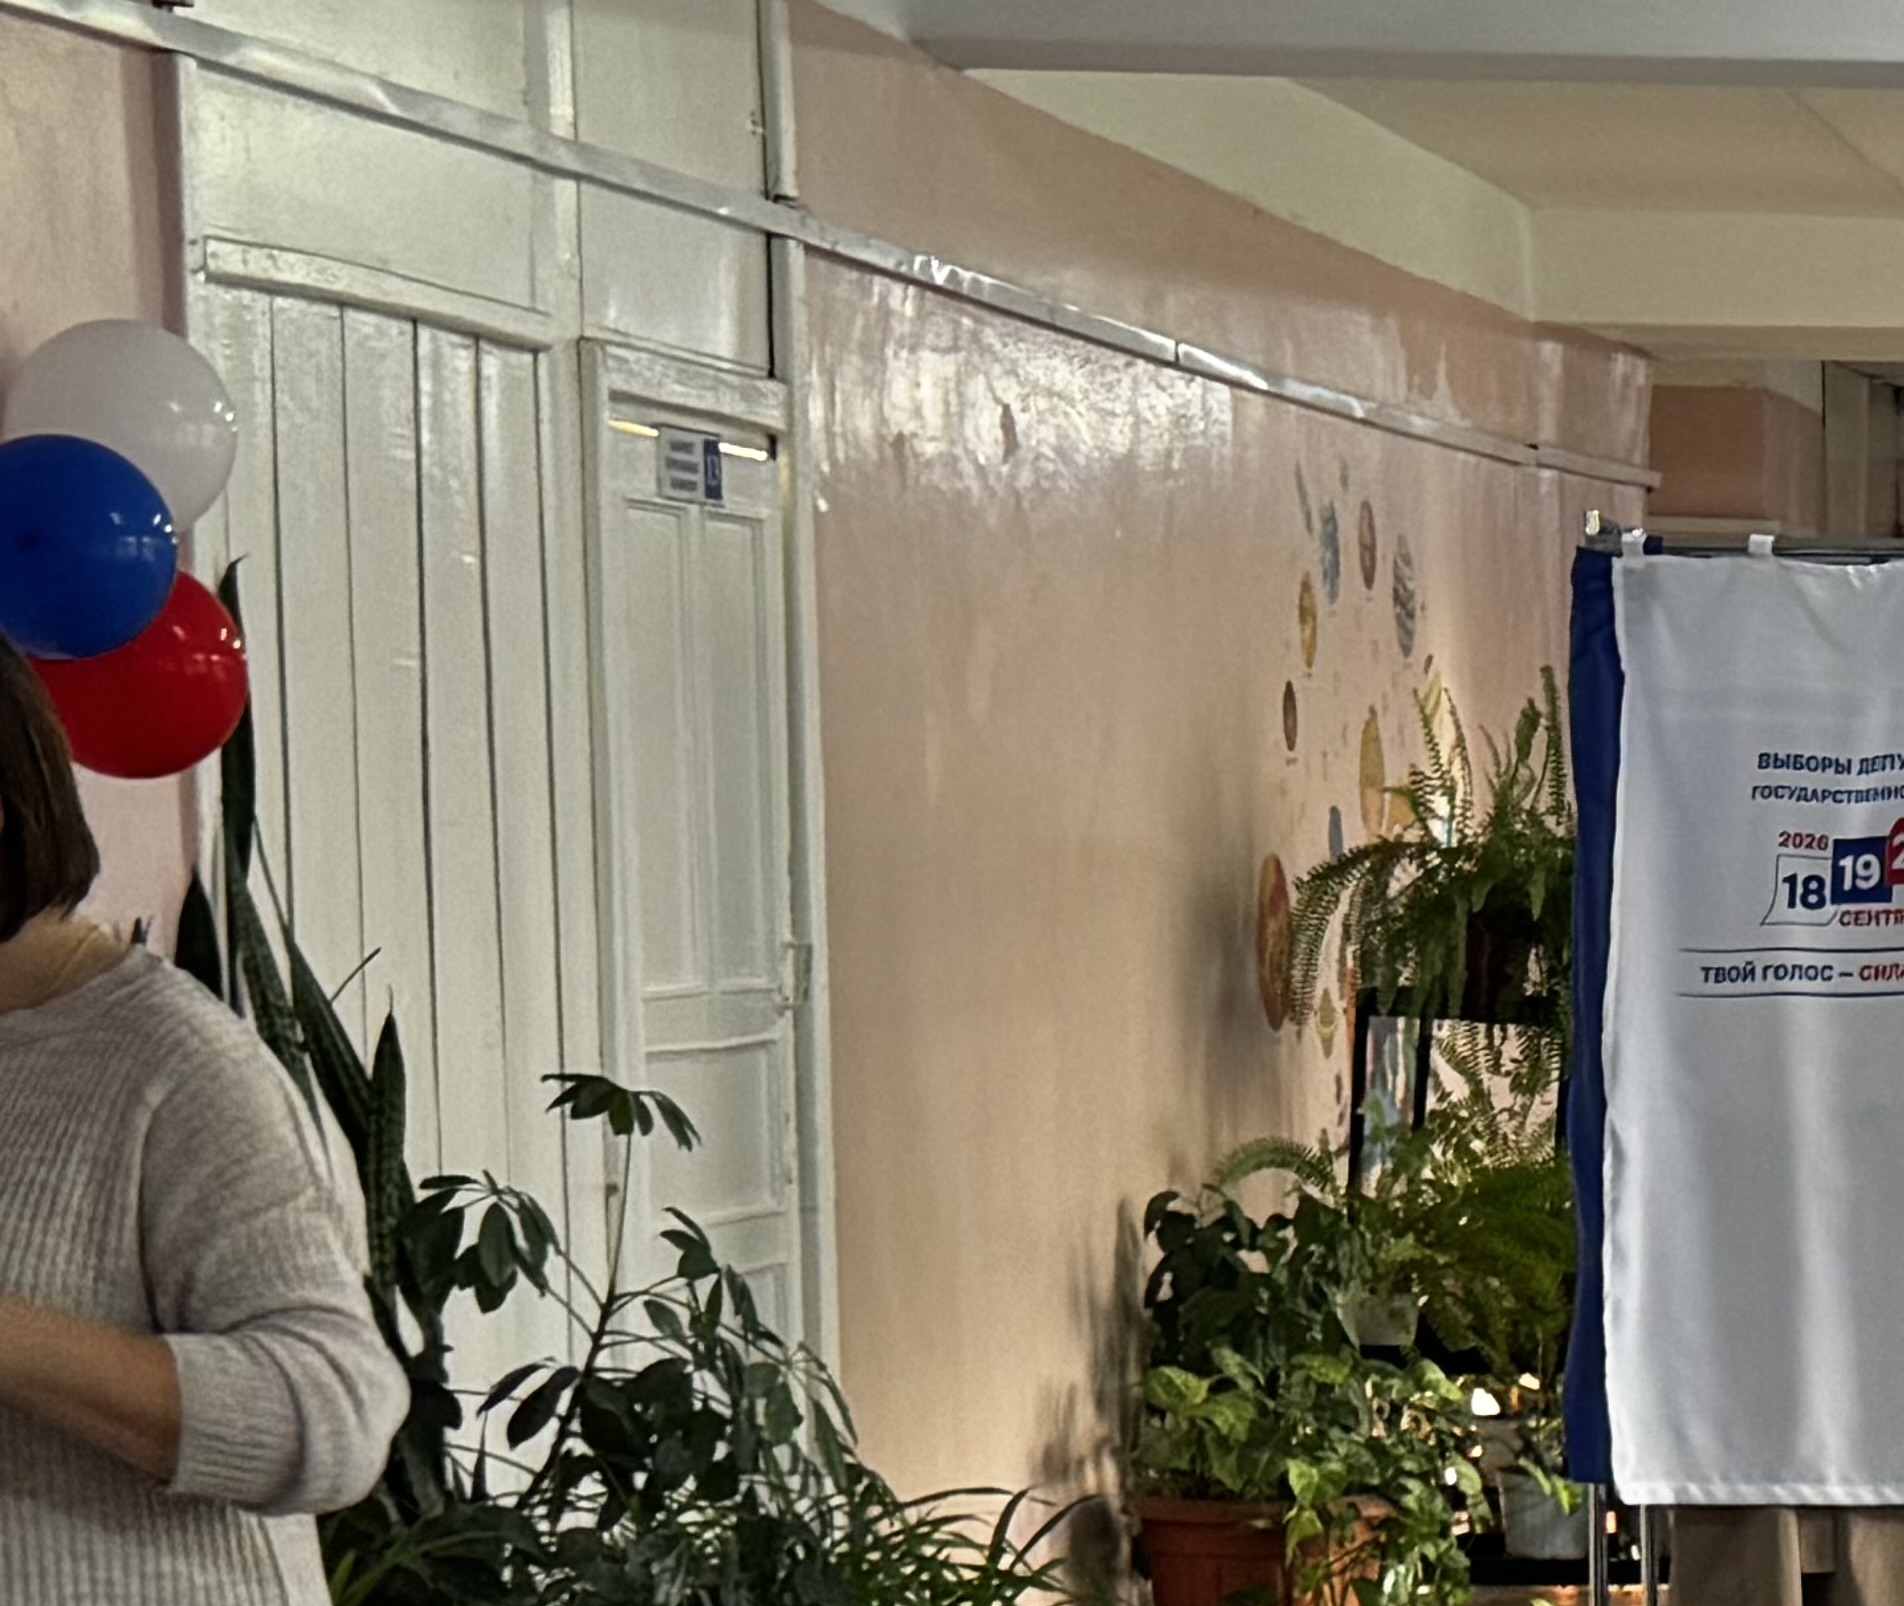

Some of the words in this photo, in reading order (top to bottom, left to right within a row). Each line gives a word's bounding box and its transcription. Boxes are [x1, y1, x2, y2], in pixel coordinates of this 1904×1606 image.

[1757, 752, 1852, 775] ВЫБОРЫ
[1778, 830, 1830, 851] 2026
[1782, 873, 1827, 910] 18
[1838, 853, 1881, 892] 19
[1701, 961, 1756, 984] ТВОЙ
[1761, 962, 1834, 982] ГОЛОС
